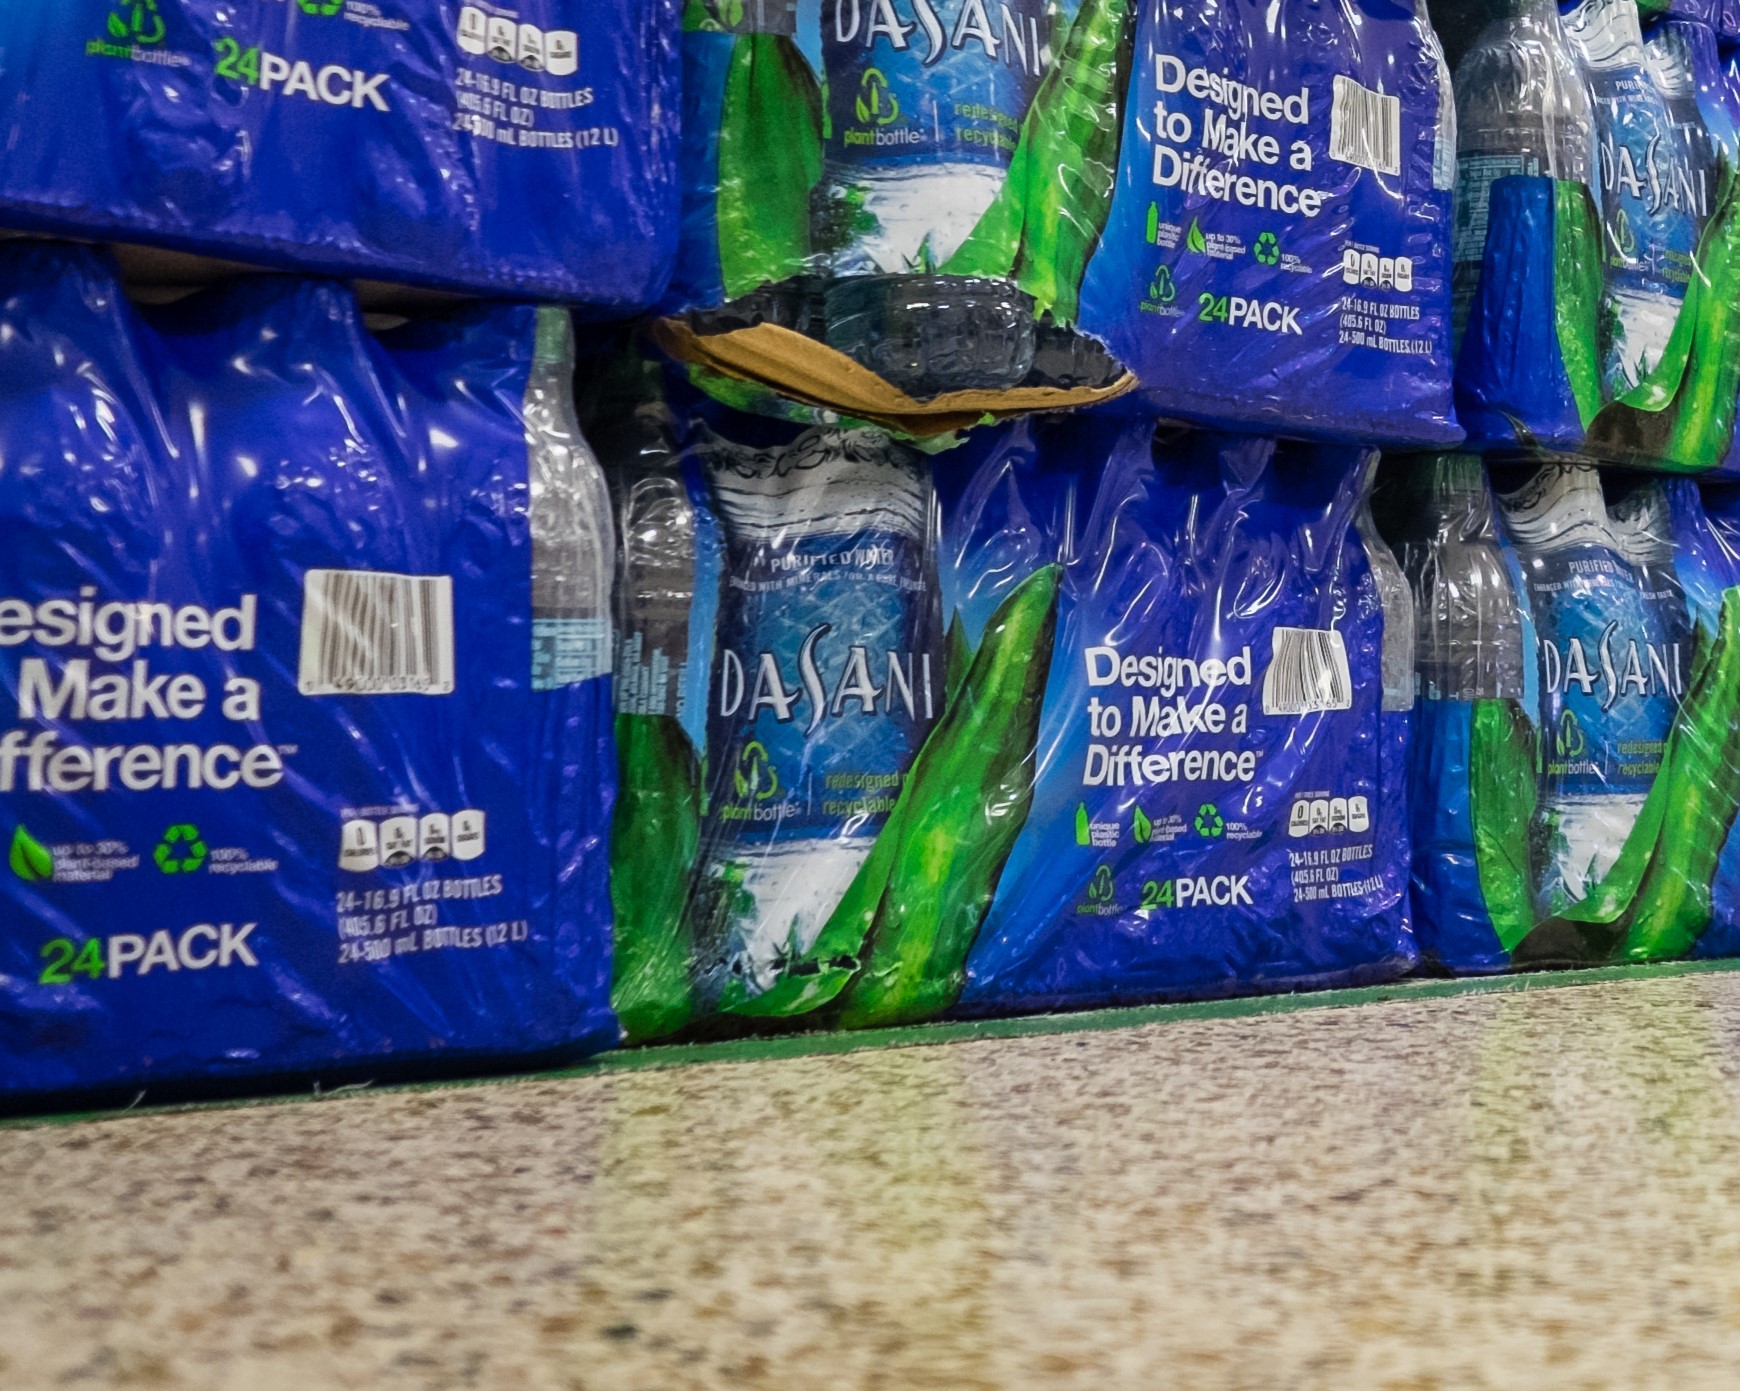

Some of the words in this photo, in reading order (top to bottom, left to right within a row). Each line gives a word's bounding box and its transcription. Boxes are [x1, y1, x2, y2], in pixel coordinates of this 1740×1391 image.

[215, 38, 391, 112] 24PACK
[1155, 53, 1309, 124] Designed
[844, 128, 920, 147] plantbottle
[1154, 100, 1192, 143] to
[1202, 109, 1279, 165] Make
[1289, 140, 1312, 171] a
[1153, 144, 1321, 218] Difference
[1601, 132, 1707, 218] DASANI
[1199, 292, 1303, 335] 24PACK
[1342, 297, 1368, 313] 24-16.9
[1370, 302, 1379, 315] FL
[1380, 304, 1388, 316] OZ
[1390, 305, 1420, 319] BOTTLES
[1364, 319, 1374, 331] FL
[1375, 320, 1386, 333] OZ)
[1367, 334, 1377, 348] mL
[770, 552, 851, 572] PURIFIED
[0, 586, 257, 662] esigned
[721, 622, 933, 738] DASANI
[1085, 646, 1251, 697] Designed
[1543, 619, 1683, 712] DASANI
[20, 658, 206, 721] Make
[222, 678, 259, 722] a
[1087, 697, 1121, 737] to
[1129, 696, 1226, 737] Make
[1231, 703, 1247, 734] a
[0, 730, 283, 792] fference
[1082, 744, 1255, 787] Difference
[722, 803, 798, 824] plantbottle
[1289, 851, 1318, 867] 24-16.9
[1320, 851, 1330, 865] FL
[1331, 849, 1340, 863] OZ
[1342, 845, 1373, 862] BOTTLES
[1290, 870, 1315, 886] (405.6
[1316, 869, 1326, 882] FL
[1327, 866, 1339, 881] OZ)
[1142, 875, 1254, 911] 24PACK
[1293, 887, 1316, 903] 24-500
[1317, 886, 1329, 901] mL
[1331, 879, 1363, 898] BOTTLES
[38, 923, 258, 986] 24PACK
